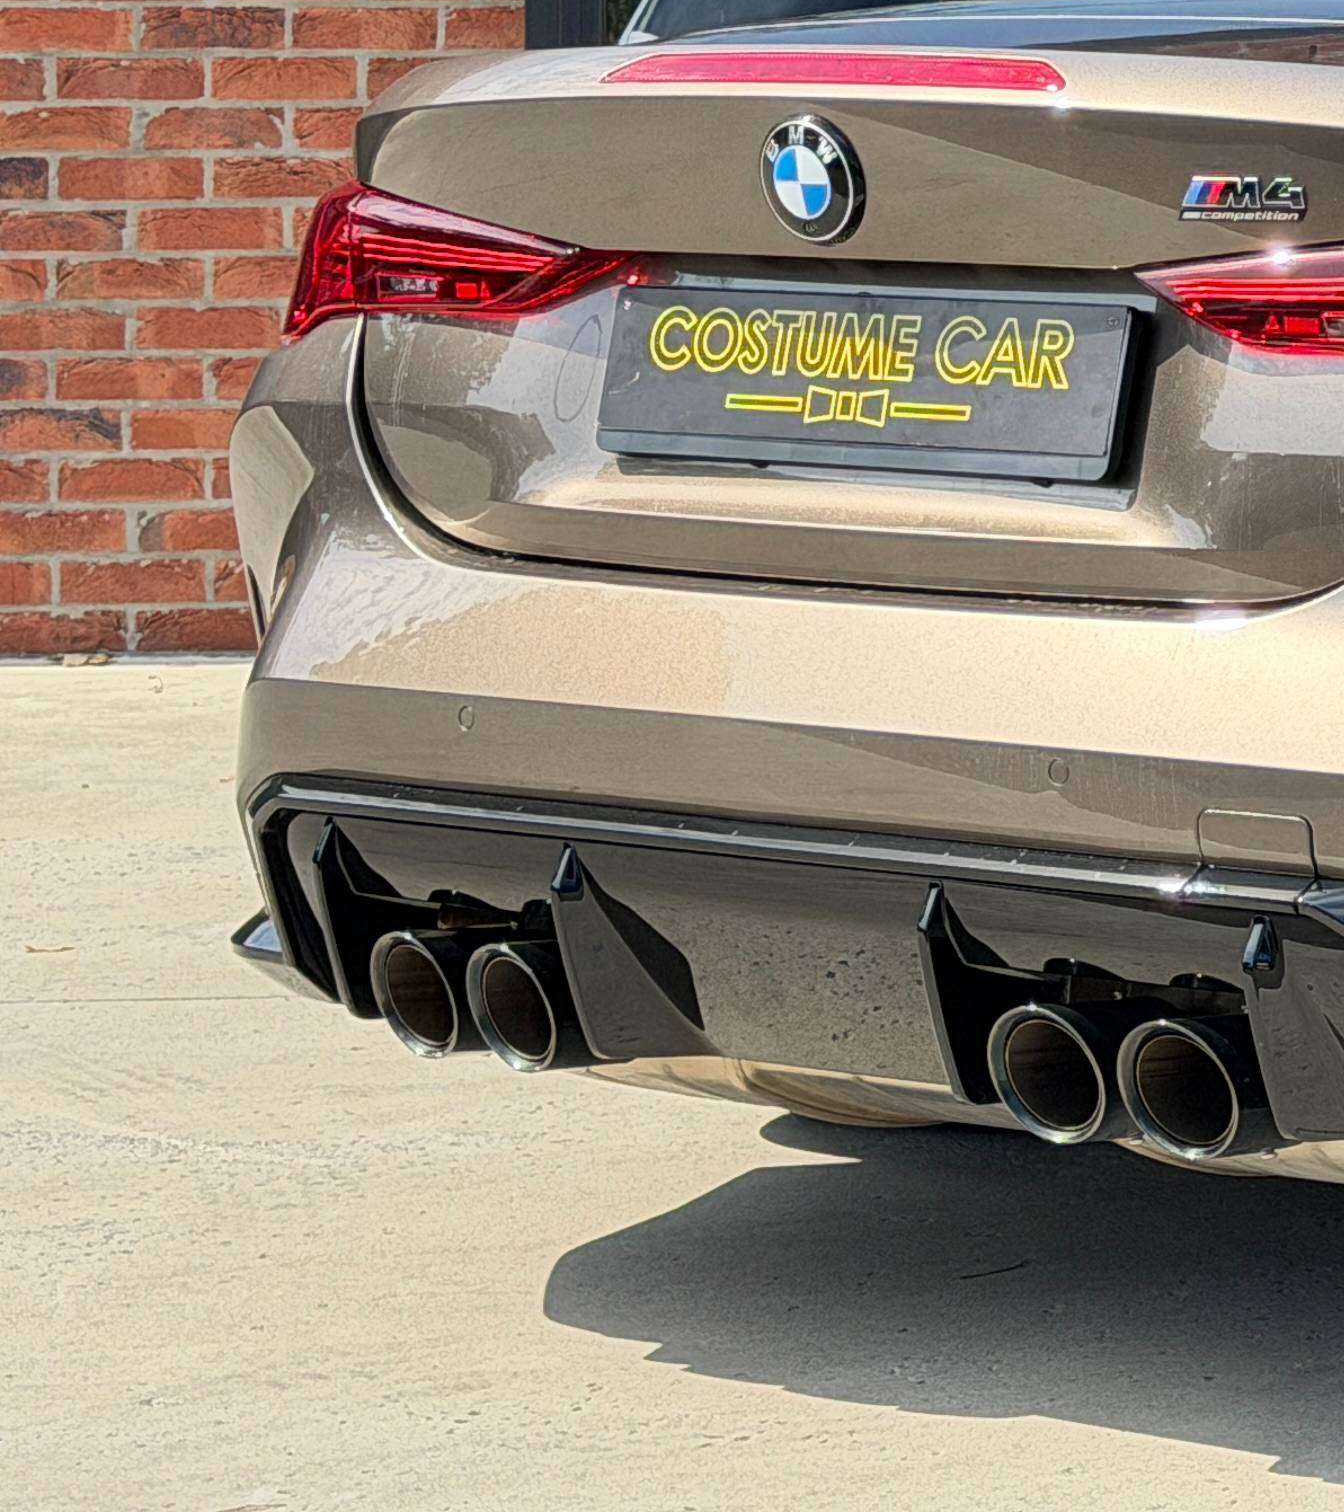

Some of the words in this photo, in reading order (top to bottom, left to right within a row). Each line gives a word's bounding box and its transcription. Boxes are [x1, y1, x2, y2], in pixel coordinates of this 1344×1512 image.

[766, 125, 838, 164] BMW
[1201, 210, 1300, 221] competition
[649, 306, 922, 382] COSTUME
[934, 314, 1076, 390] CAR
